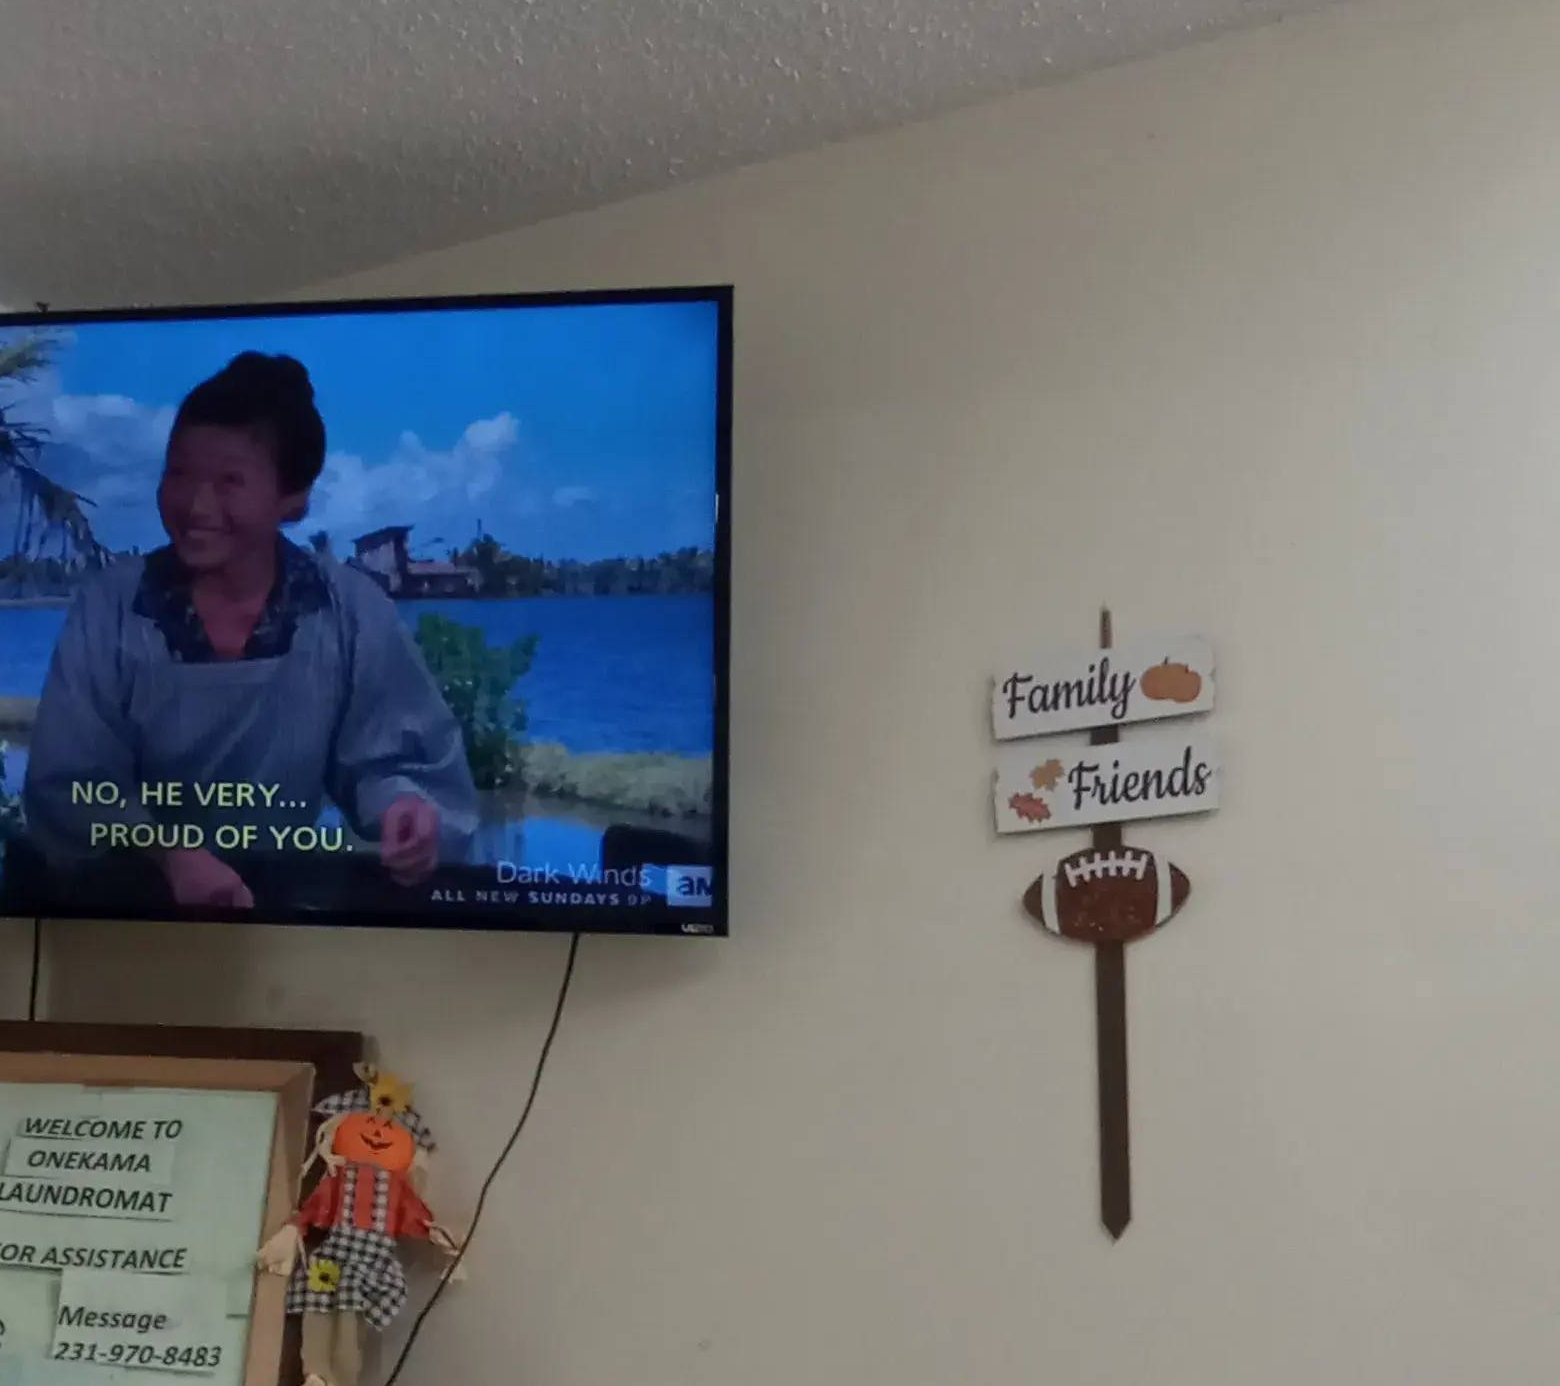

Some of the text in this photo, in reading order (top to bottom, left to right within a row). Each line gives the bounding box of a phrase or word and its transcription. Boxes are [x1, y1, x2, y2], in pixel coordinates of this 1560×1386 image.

[1002, 657, 1137, 719] Family
[1067, 746, 1213, 811] Friends
[71, 781, 307, 808] NO, HE VERY...
[90, 822, 353, 852] PROUD OF YOU.
[496, 860, 653, 888] Dark Winds
[431, 889, 466, 902] ALL
[476, 890, 519, 904] NEW
[528, 891, 620, 906] SUNDAYS
[25, 1116, 184, 1140] WELCOME TO
[26, 1149, 153, 1173] ONEKAMA
[40, 1246, 188, 1270] ASSISTANCE
[57, 1305, 168, 1334] Message
[53, 1341, 222, 1368] 231-970-8483
